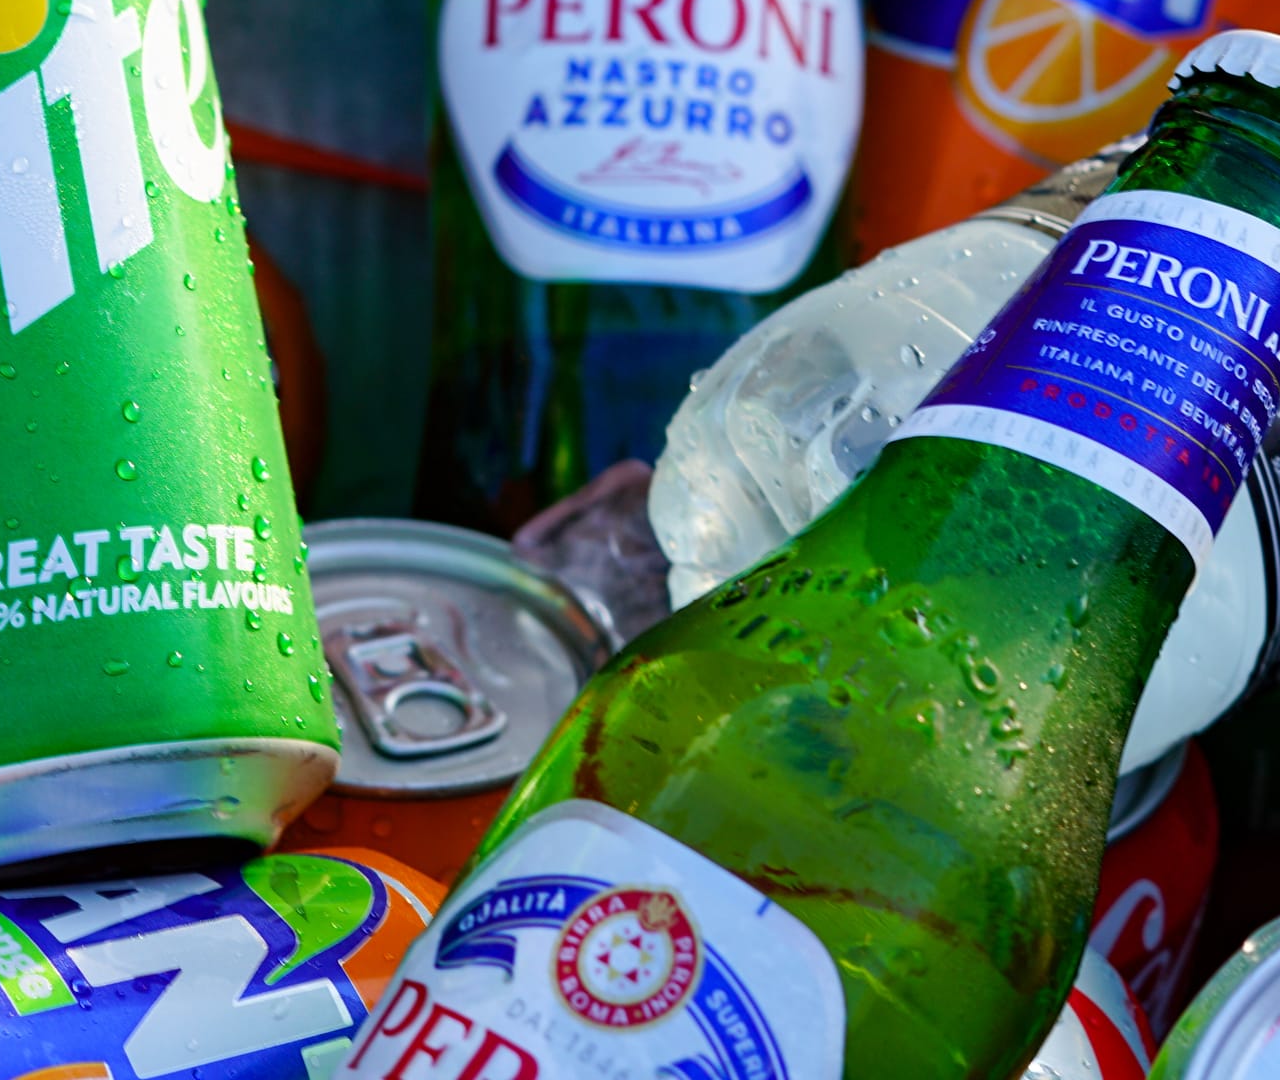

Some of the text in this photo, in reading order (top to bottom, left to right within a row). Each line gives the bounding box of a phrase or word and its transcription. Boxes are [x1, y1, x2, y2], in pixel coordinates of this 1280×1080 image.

[565, 56, 756, 98] NASTRO
[524, 92, 796, 146] AZZURRO
[562, 204, 745, 245] ITALIANA
[1070, 238, 1271, 341] PERONI
[1080, 297, 1098, 315] IL
[1106, 304, 1185, 343] GUSTO
[1033, 318, 1190, 379] RINFRESCANTE
[1191, 371, 1240, 416] DELLA
[1039, 344, 1136, 386] ITALIANA
[1141, 377, 1177, 407] PIÙ
[1021, 377, 1191, 466] PRODOTTA
[120, 522, 256, 573] TASTE
[30, 580, 178, 624] NATURAL
[181, 578, 293, 617] FLAVOURS
[458, 887, 568, 933] QUALITÀ
[558, 894, 695, 1020] BIRRA PERONI
[347, 978, 542, 1080] PER
[567, 983, 631, 1028] ROMA
[709, 988, 775, 1080] SUPERI
